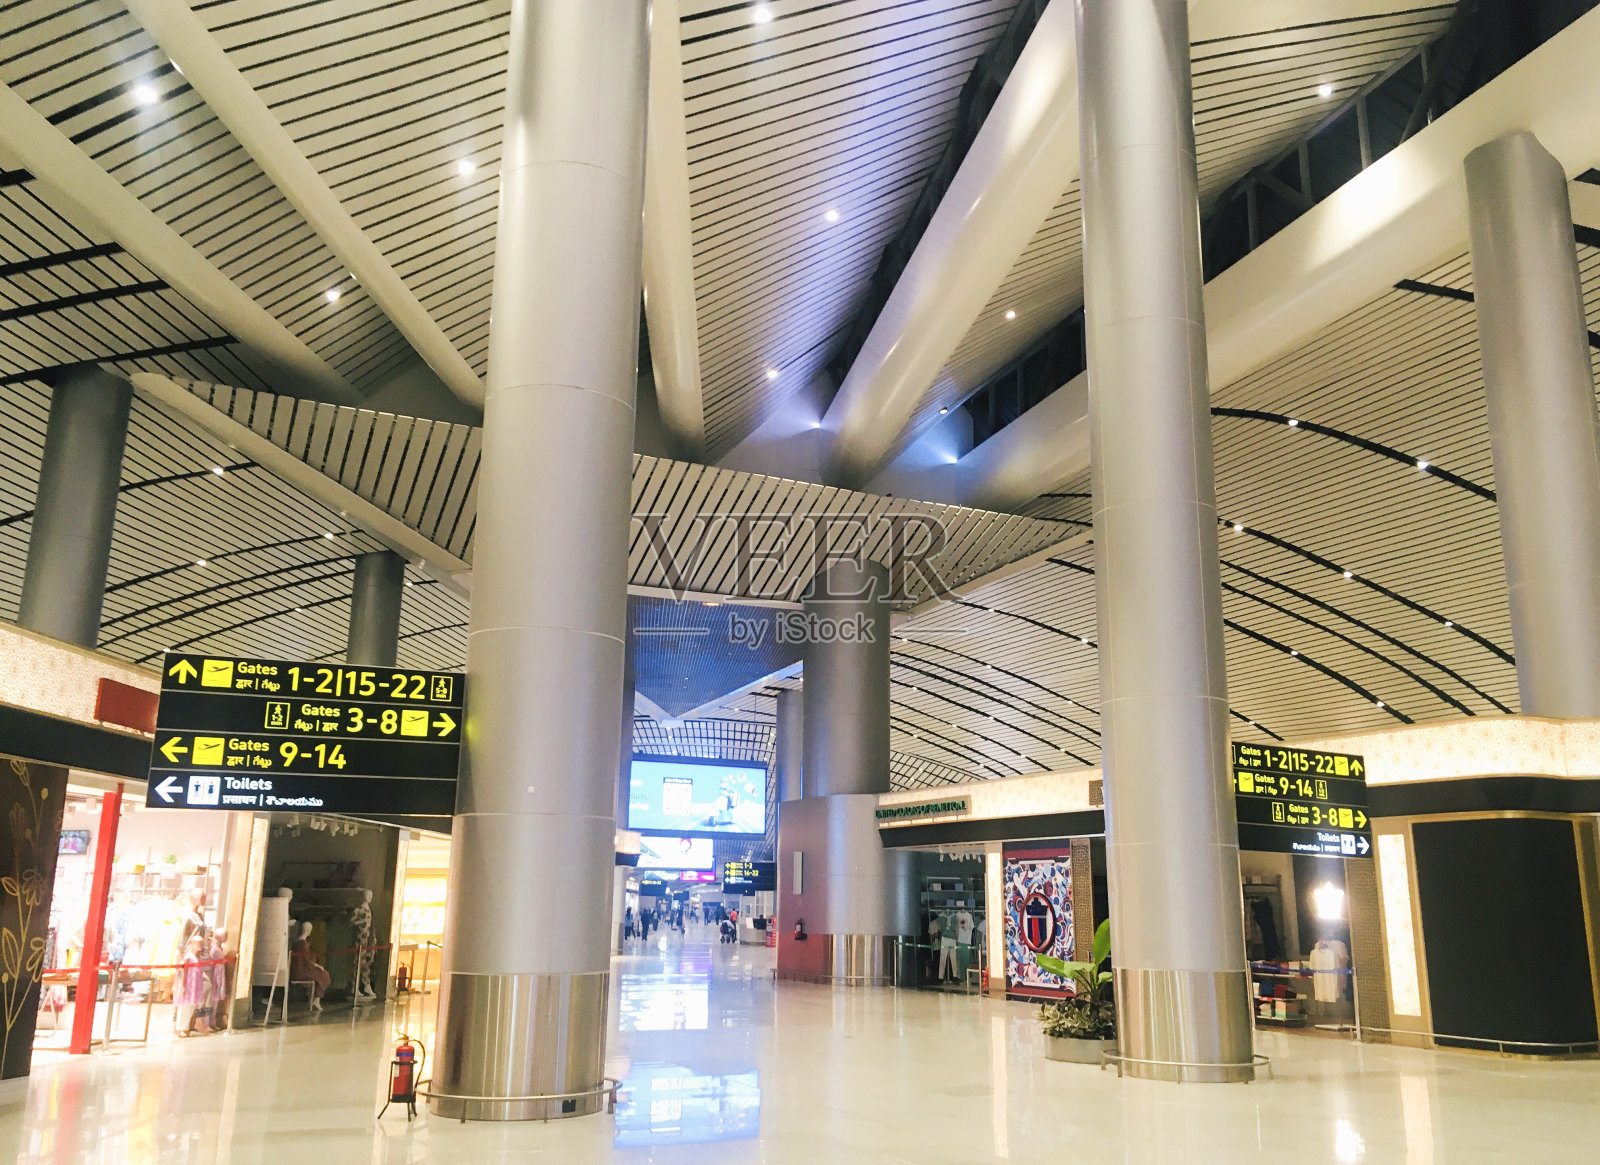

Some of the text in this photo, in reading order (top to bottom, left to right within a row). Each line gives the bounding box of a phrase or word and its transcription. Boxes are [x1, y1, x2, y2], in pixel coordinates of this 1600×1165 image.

[237, 661, 278, 676] Gates
[301, 703, 398, 735] Gates 3-8
[228, 738, 347, 770] Gates 9-14
[1241, 746, 1261, 756] Gates
[224, 776, 273, 791] Toilets
[1255, 774, 1275, 783] Gates
[1279, 776, 1314, 798] 9-14
[1289, 804, 1308, 813] Gates
[1311, 806, 1338, 827] 3-8
[1317, 832, 1340, 842] Toilets
